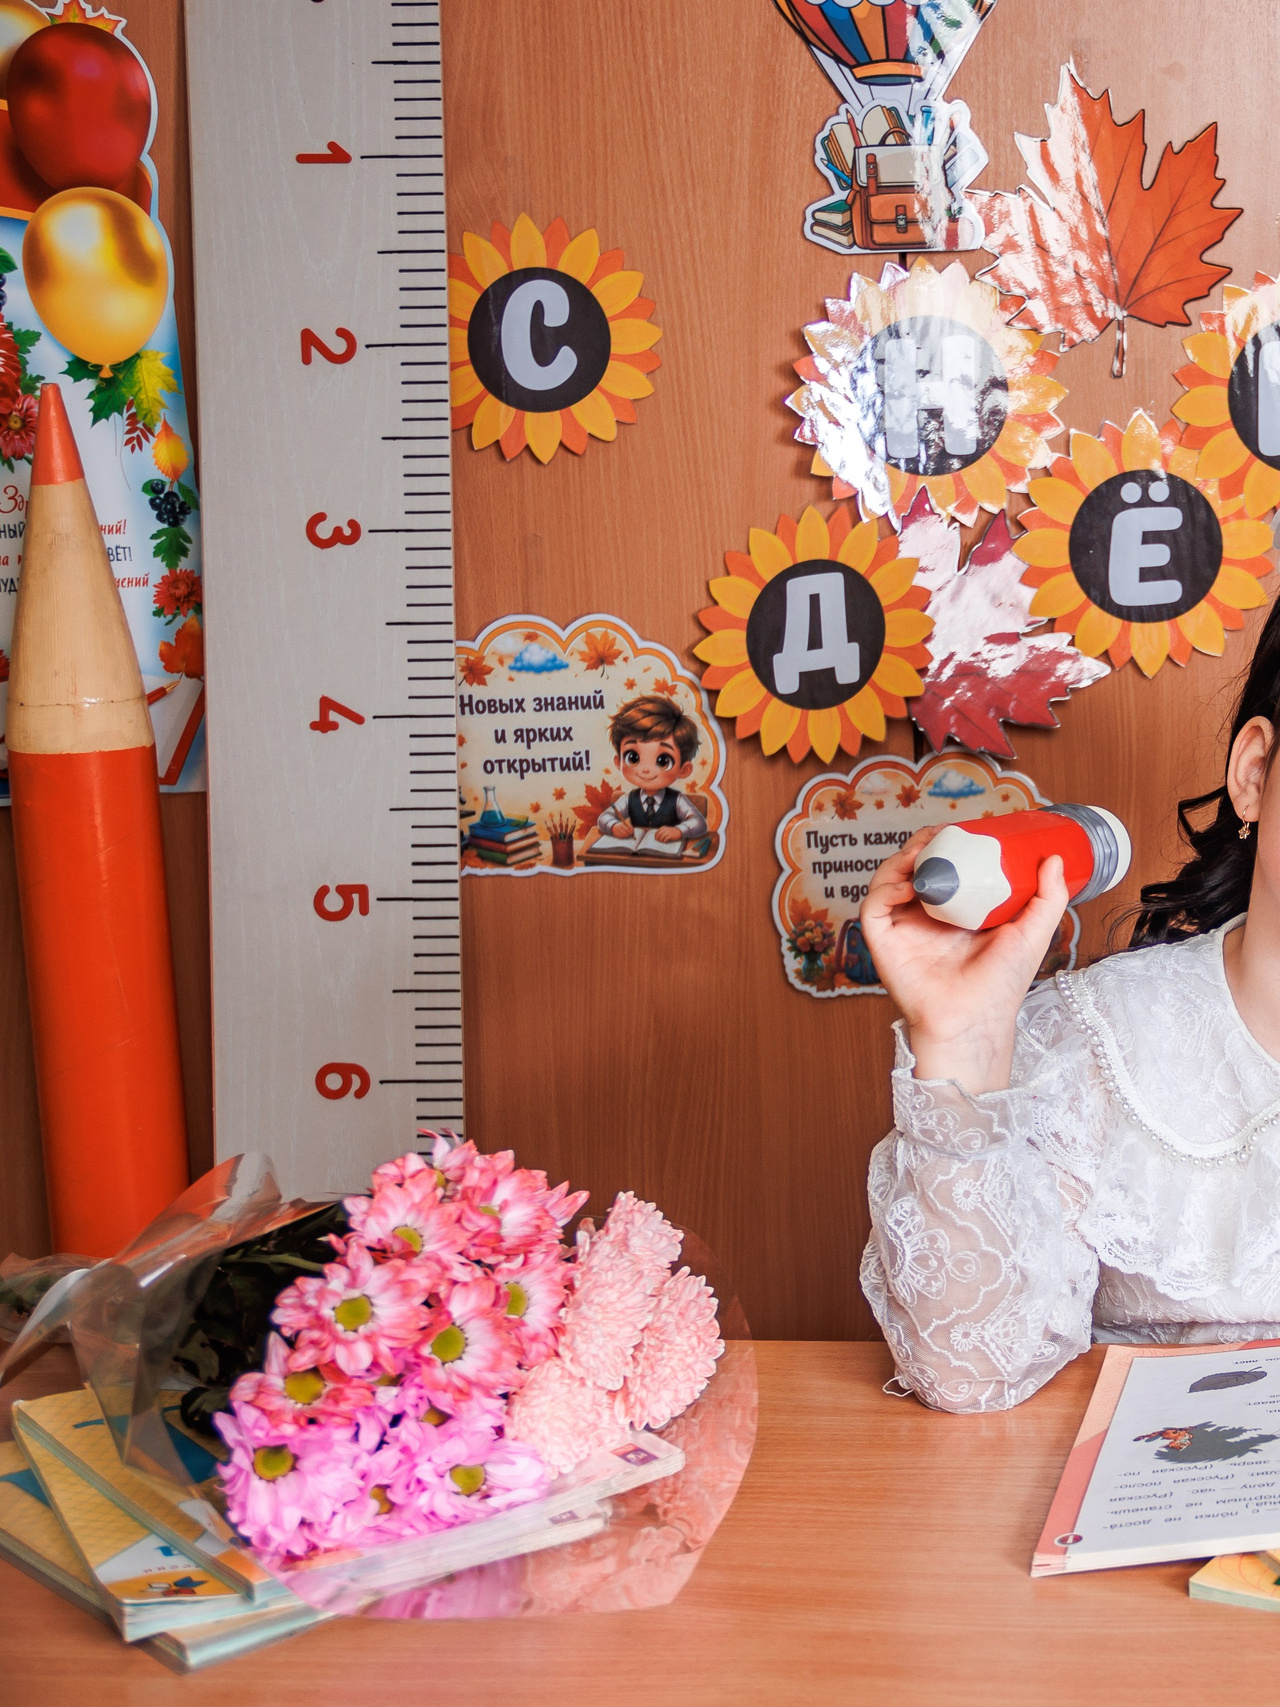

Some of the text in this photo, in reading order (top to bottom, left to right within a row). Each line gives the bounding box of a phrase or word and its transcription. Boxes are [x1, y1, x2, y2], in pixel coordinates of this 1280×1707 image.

[296, 141, 352, 164] 1
[301, 327, 357, 365] 2
[501, 279, 577, 391] С
[885, 335, 977, 459] Н
[305, 512, 362, 548] 3
[1108, 481, 1183, 607] Ё
[773, 572, 860, 695] Д
[309, 696, 366, 734] 4
[459, 690, 605, 716] Новых знаний
[494, 726, 574, 750] и ярких
[483, 750, 591, 780] открытий!
[805, 830, 858, 854] Пусть
[313, 884, 369, 921] 5
[825, 885, 835, 900] и
[315, 1062, 371, 1100] 6
